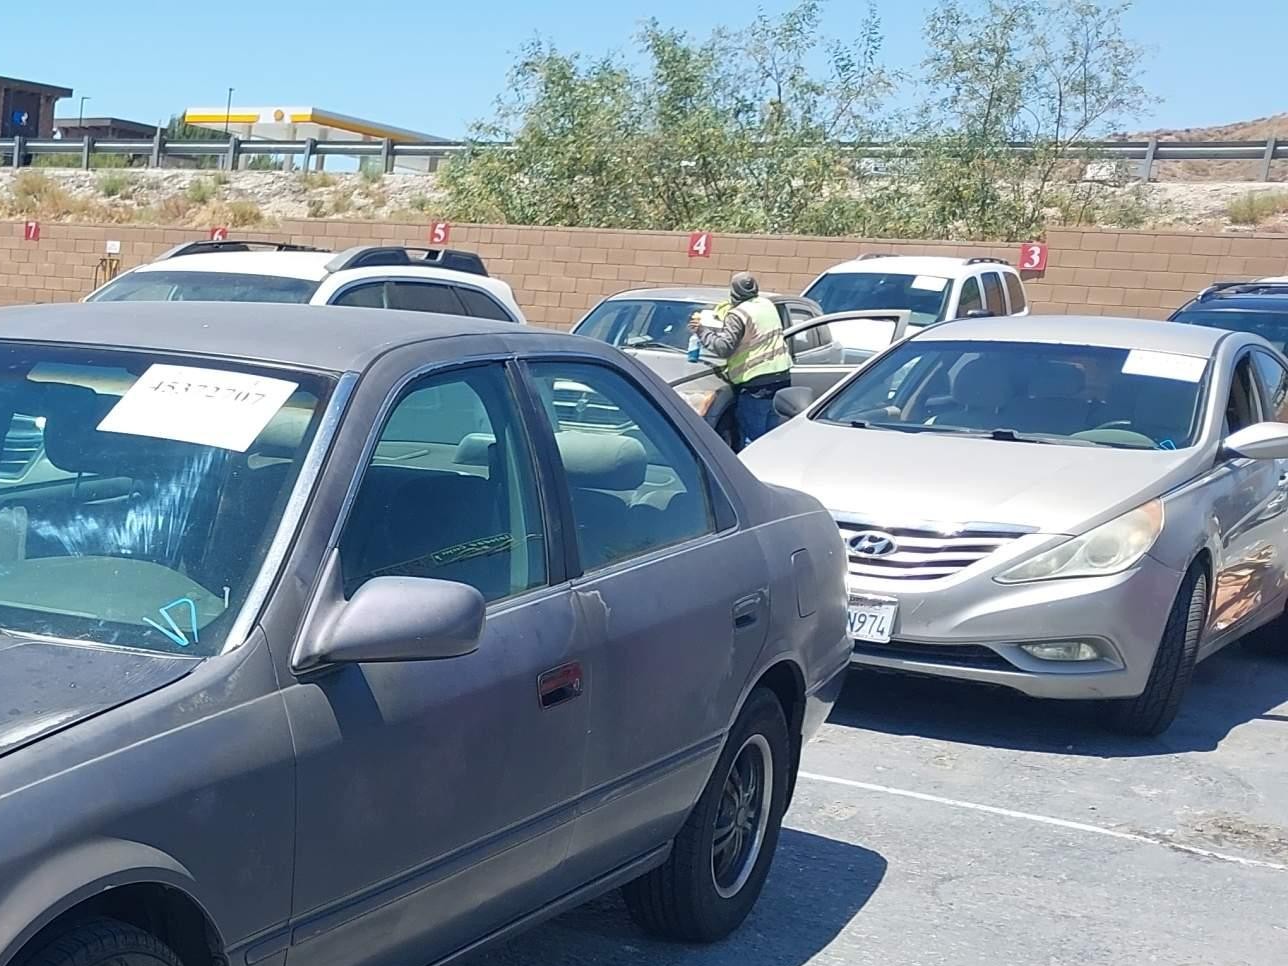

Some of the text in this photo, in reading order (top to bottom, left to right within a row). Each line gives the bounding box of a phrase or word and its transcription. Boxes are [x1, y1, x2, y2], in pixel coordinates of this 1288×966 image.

[434, 223, 447, 243] 5
[693, 234, 707, 255] 4
[1024, 247, 1041, 268] 3
